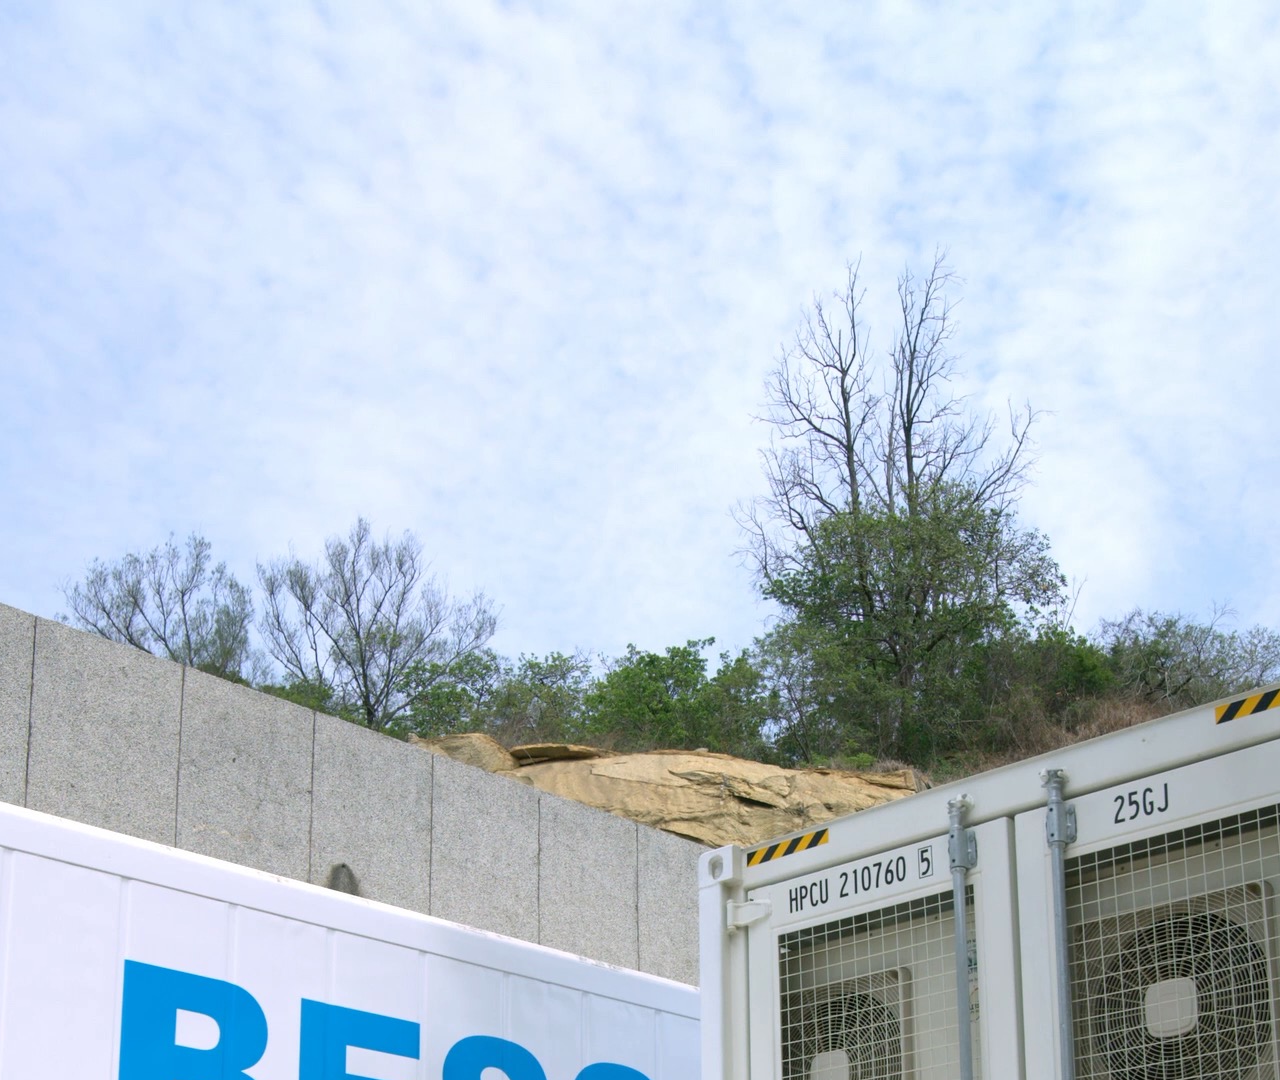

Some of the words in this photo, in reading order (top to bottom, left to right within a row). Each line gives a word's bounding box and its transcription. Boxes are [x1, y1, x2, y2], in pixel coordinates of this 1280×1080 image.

[1114, 782, 1170, 825] 25GJ
[789, 877, 829, 914] HPCU
[839, 855, 907, 898] 210760
[919, 847, 932, 877] 5
